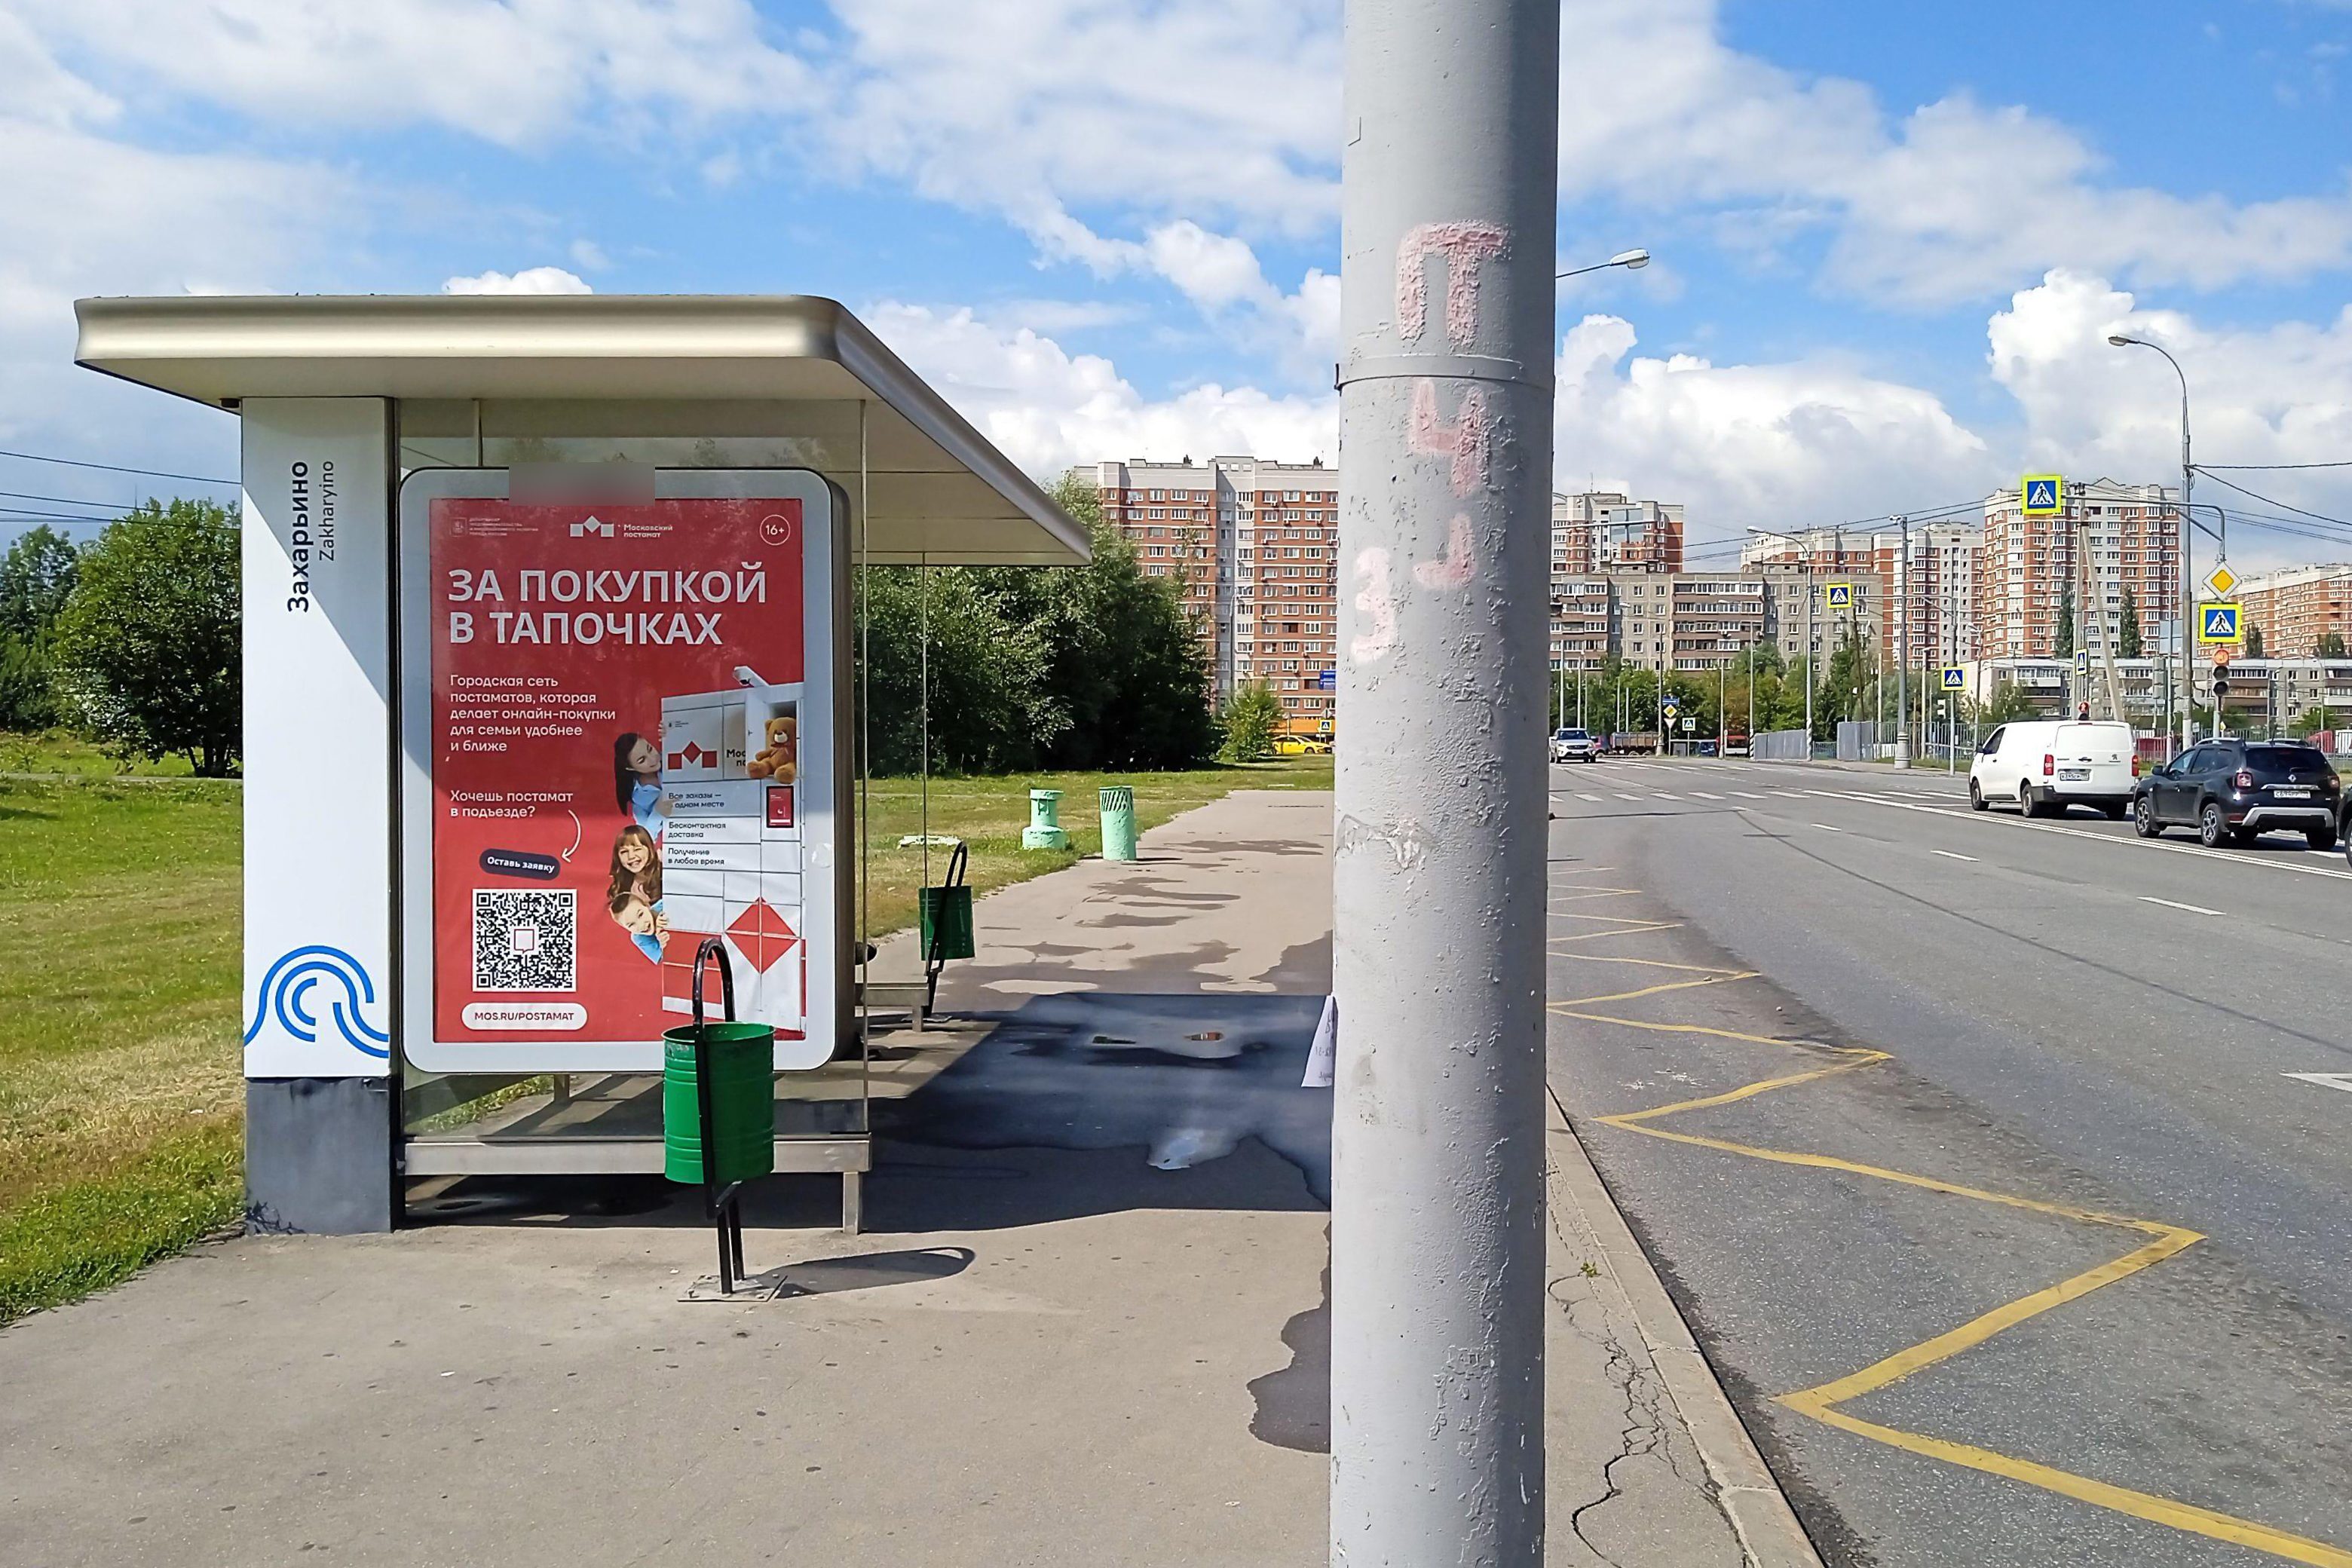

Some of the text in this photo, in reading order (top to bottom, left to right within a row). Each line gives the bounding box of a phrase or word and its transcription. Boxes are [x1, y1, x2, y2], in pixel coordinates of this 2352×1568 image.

[318, 461, 338, 562] Zakharyino
[623, 523, 673, 531] Московский
[765, 524, 785, 535] 16+
[287, 461, 314, 613] Захарьино
[448, 561, 767, 603] ЗА ПОКУПКОЙ
[450, 611, 723, 645] В ТАПОЧКАХ
[450, 675, 559, 688] Городская сеть
[450, 693, 596, 706] постаматов, которая
[450, 707, 616, 723] делает онлайн-покупки
[450, 724, 583, 738] для семьи удобнее
[451, 740, 507, 752] и ближе
[451, 790, 573, 801] Хочешь постамат
[451, 806, 535, 819] в подъезде?
[668, 848, 710, 856] Получение
[487, 856, 555, 873] Оставь заявку
[674, 856, 699, 865] любое
[474, 1012, 574, 1021] MOS.RU/POSTAMAT
